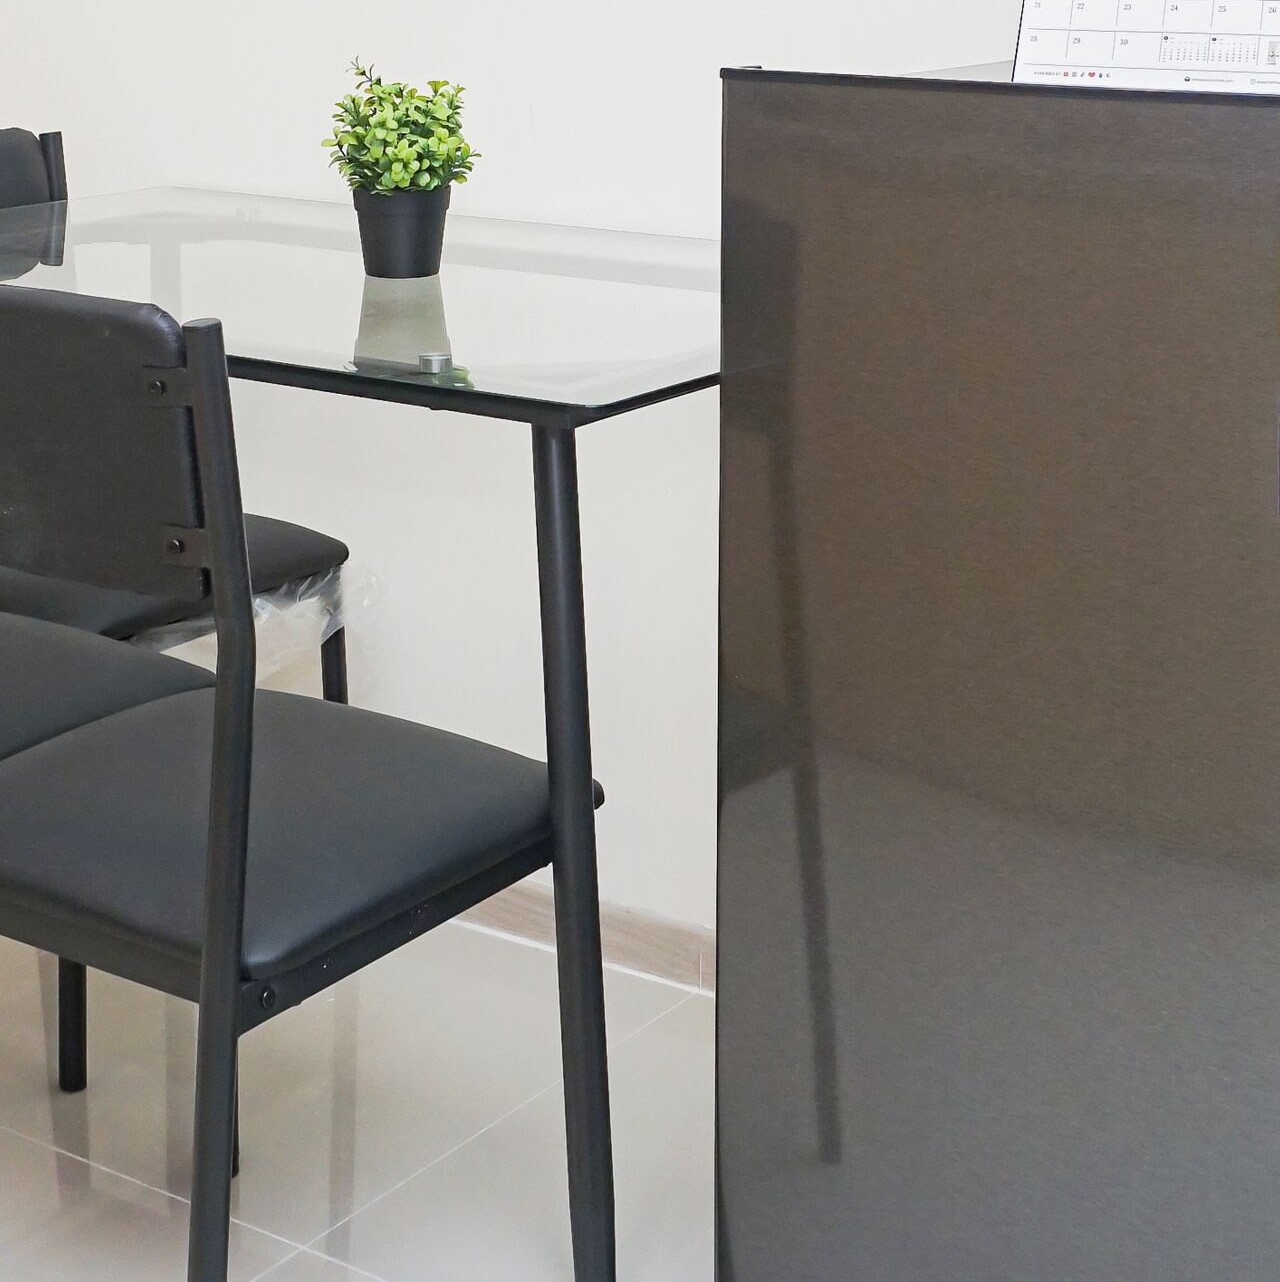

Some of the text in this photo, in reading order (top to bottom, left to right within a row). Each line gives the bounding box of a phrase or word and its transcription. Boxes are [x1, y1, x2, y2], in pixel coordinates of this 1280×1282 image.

[1034, 1, 1041, 9] 21
[1076, 2, 1085, 10] 22
[1123, 3, 1132, 11] 23
[1169, 4, 1179, 12] 24
[1217, 5, 1227, 13] 25
[1267, 6, 1278, 14] 26
[1072, 37, 1081, 45] 29
[1119, 38, 1129, 46] 30
